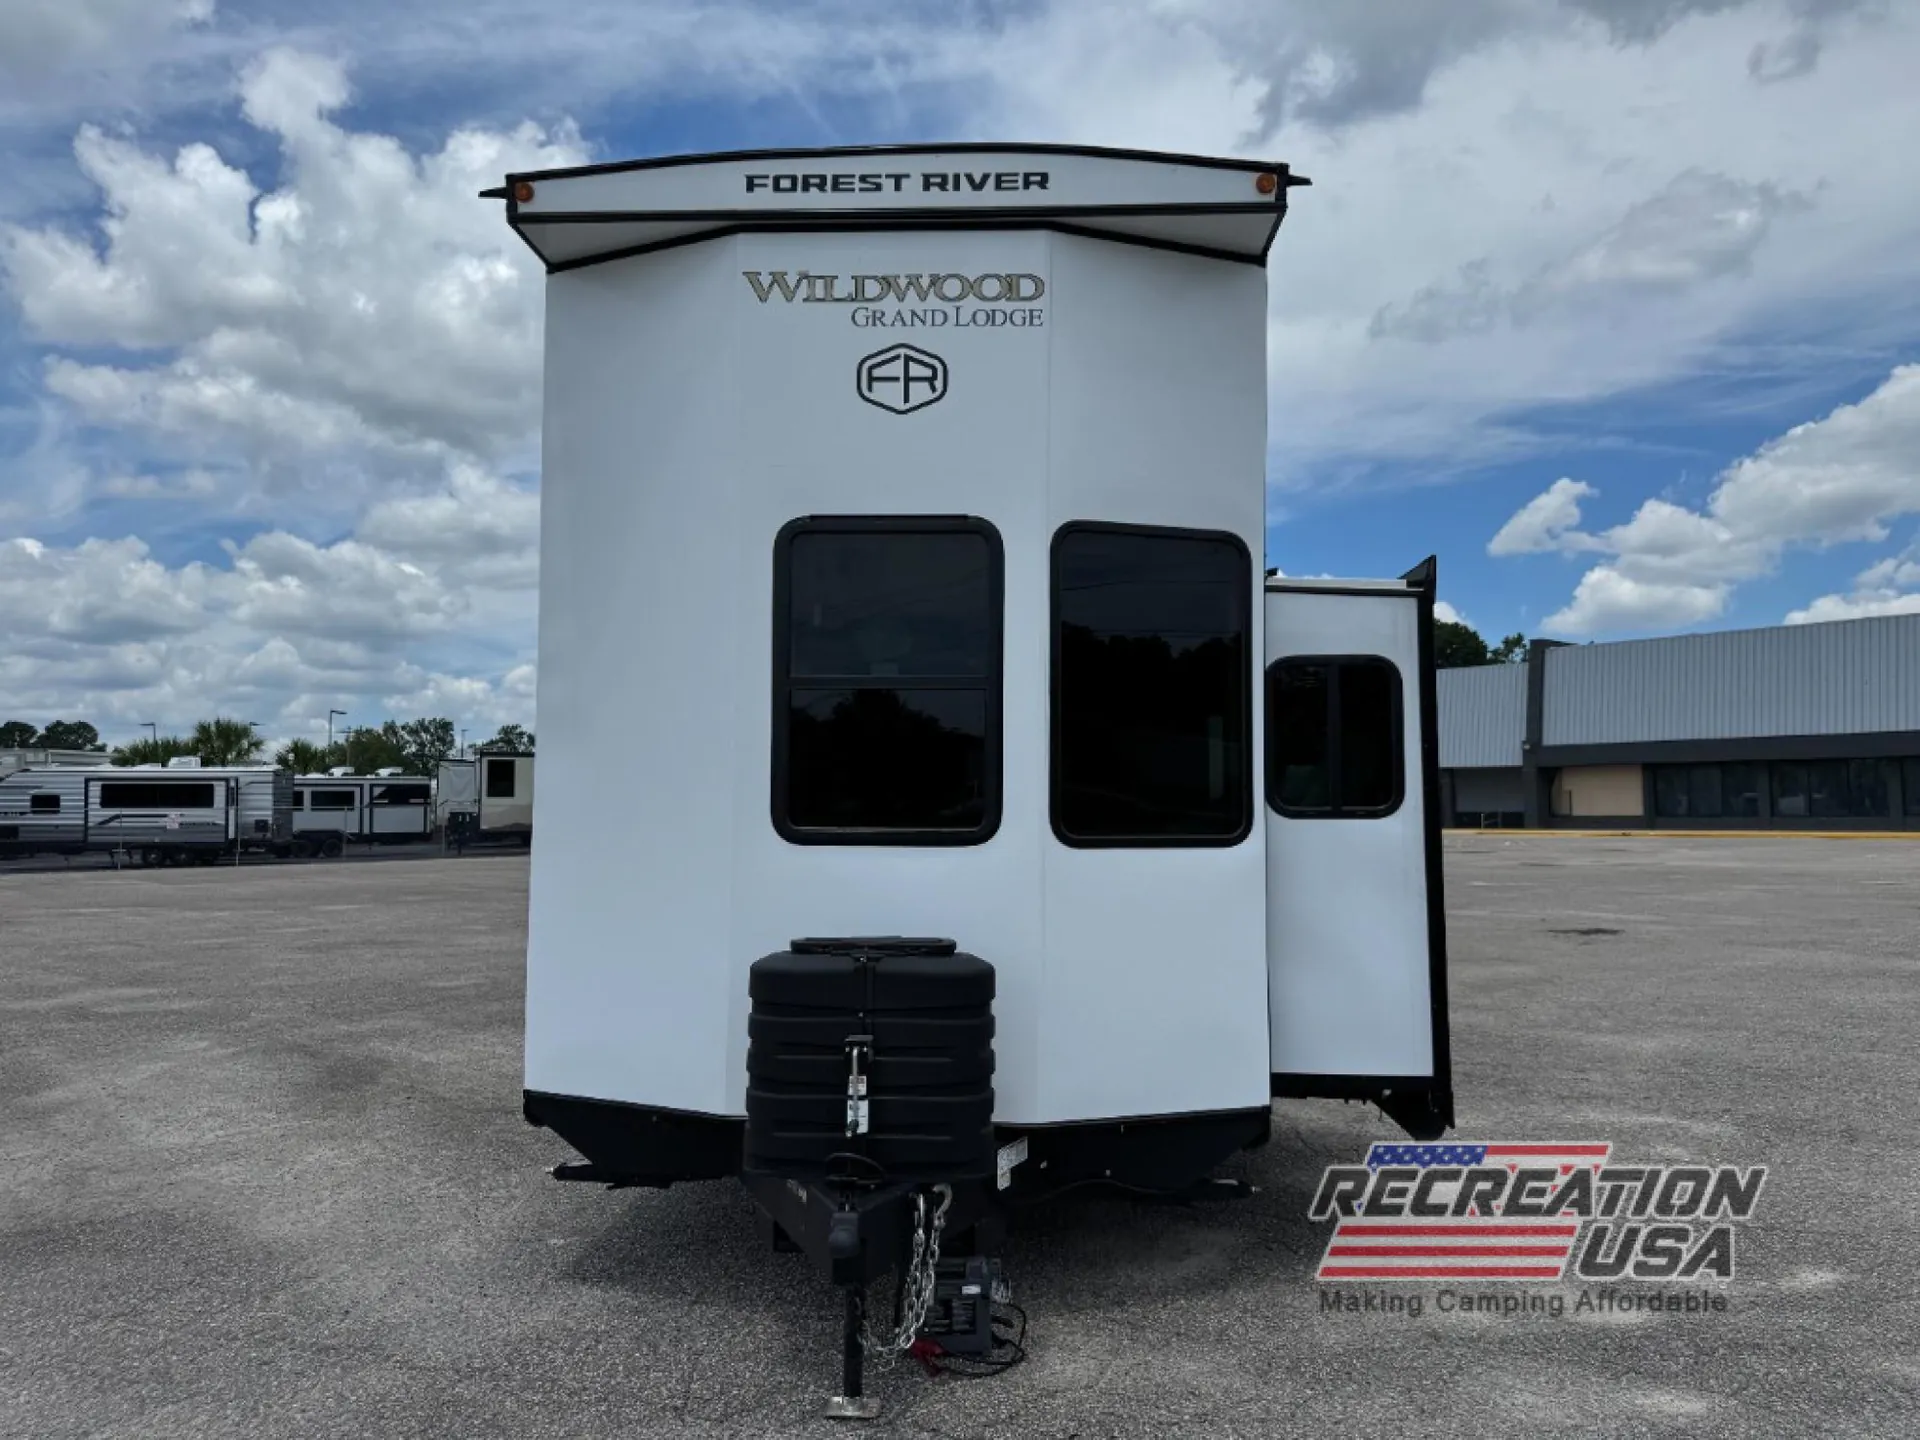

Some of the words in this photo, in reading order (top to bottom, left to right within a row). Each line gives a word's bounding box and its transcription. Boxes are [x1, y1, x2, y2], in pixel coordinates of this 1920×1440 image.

[745, 173, 911, 194] FOREST
[920, 171, 1050, 192] RIVER
[742, 270, 1046, 303] WILDWOOD
[851, 306, 949, 328] GRAND
[951, 305, 1045, 328] LODGE
